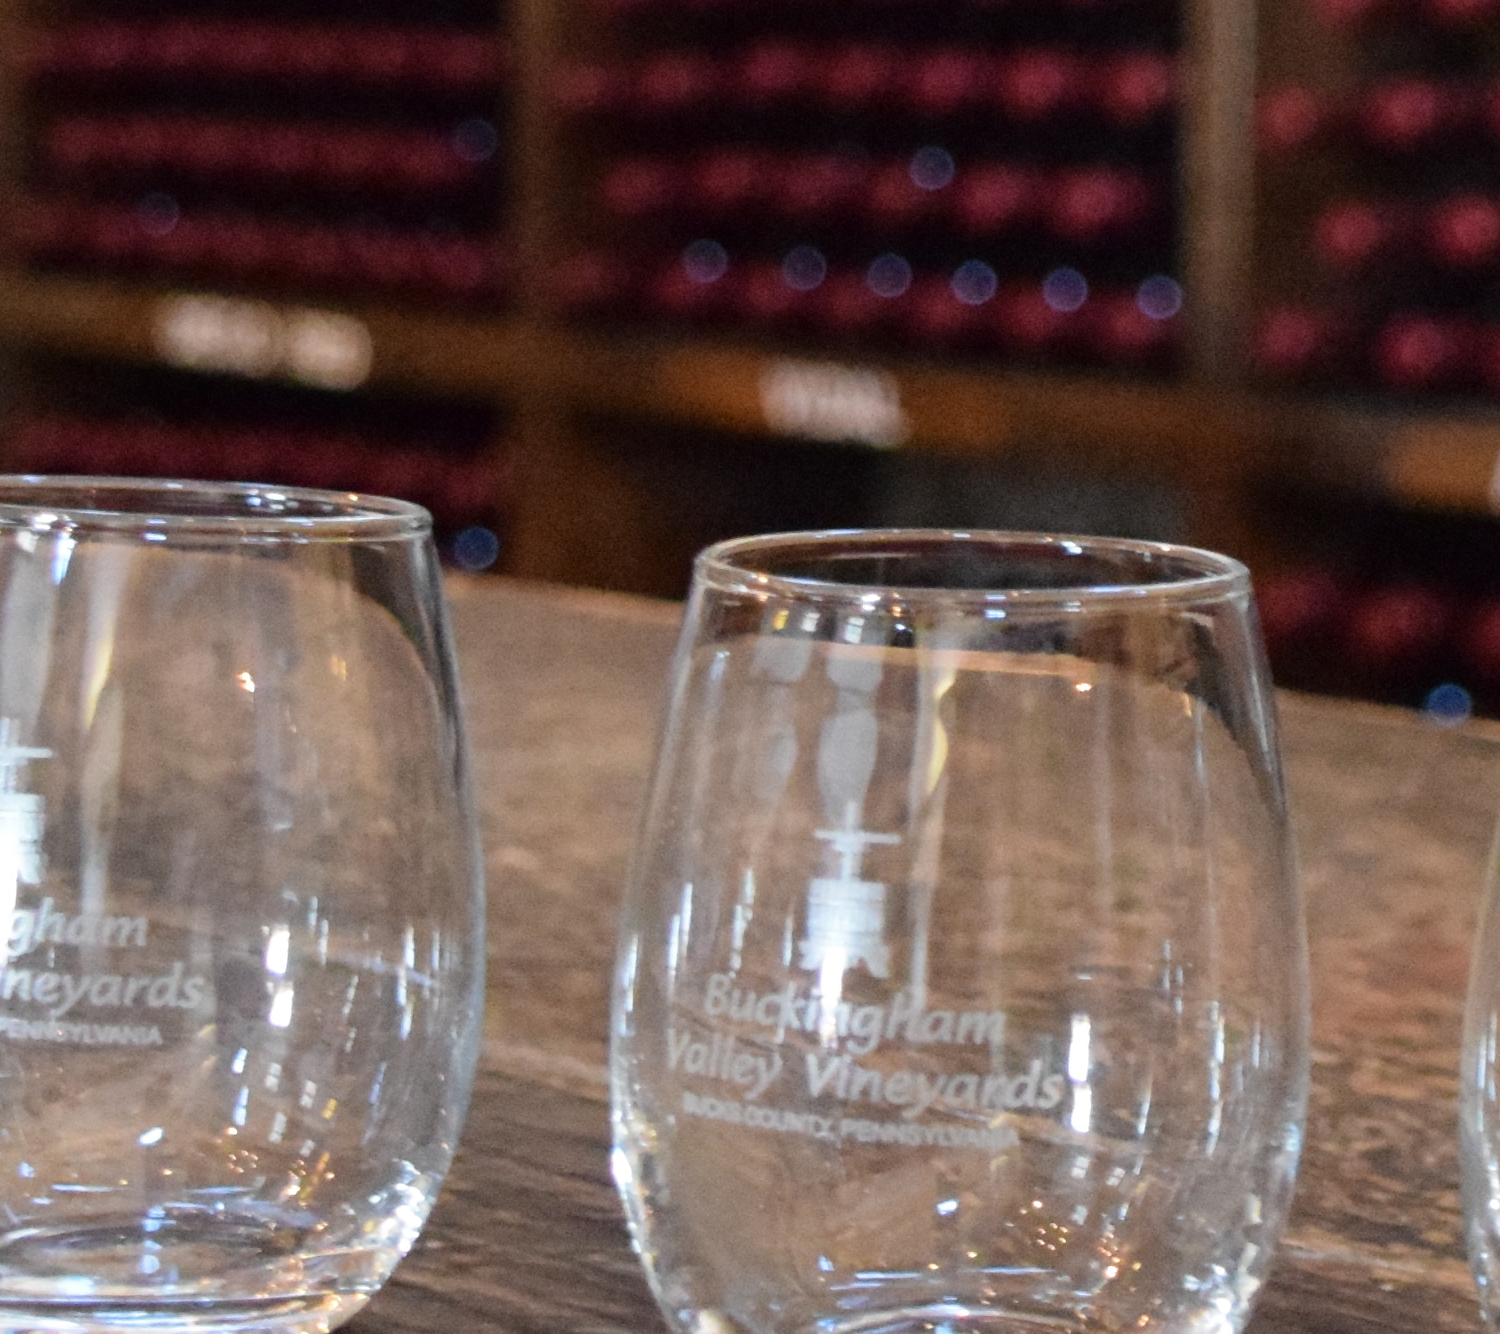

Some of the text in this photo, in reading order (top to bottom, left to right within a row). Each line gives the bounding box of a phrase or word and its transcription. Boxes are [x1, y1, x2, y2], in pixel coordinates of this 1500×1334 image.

[704, 974, 1006, 1054] Buckingham
[667, 1028, 1065, 1118] Valley Vineyards
